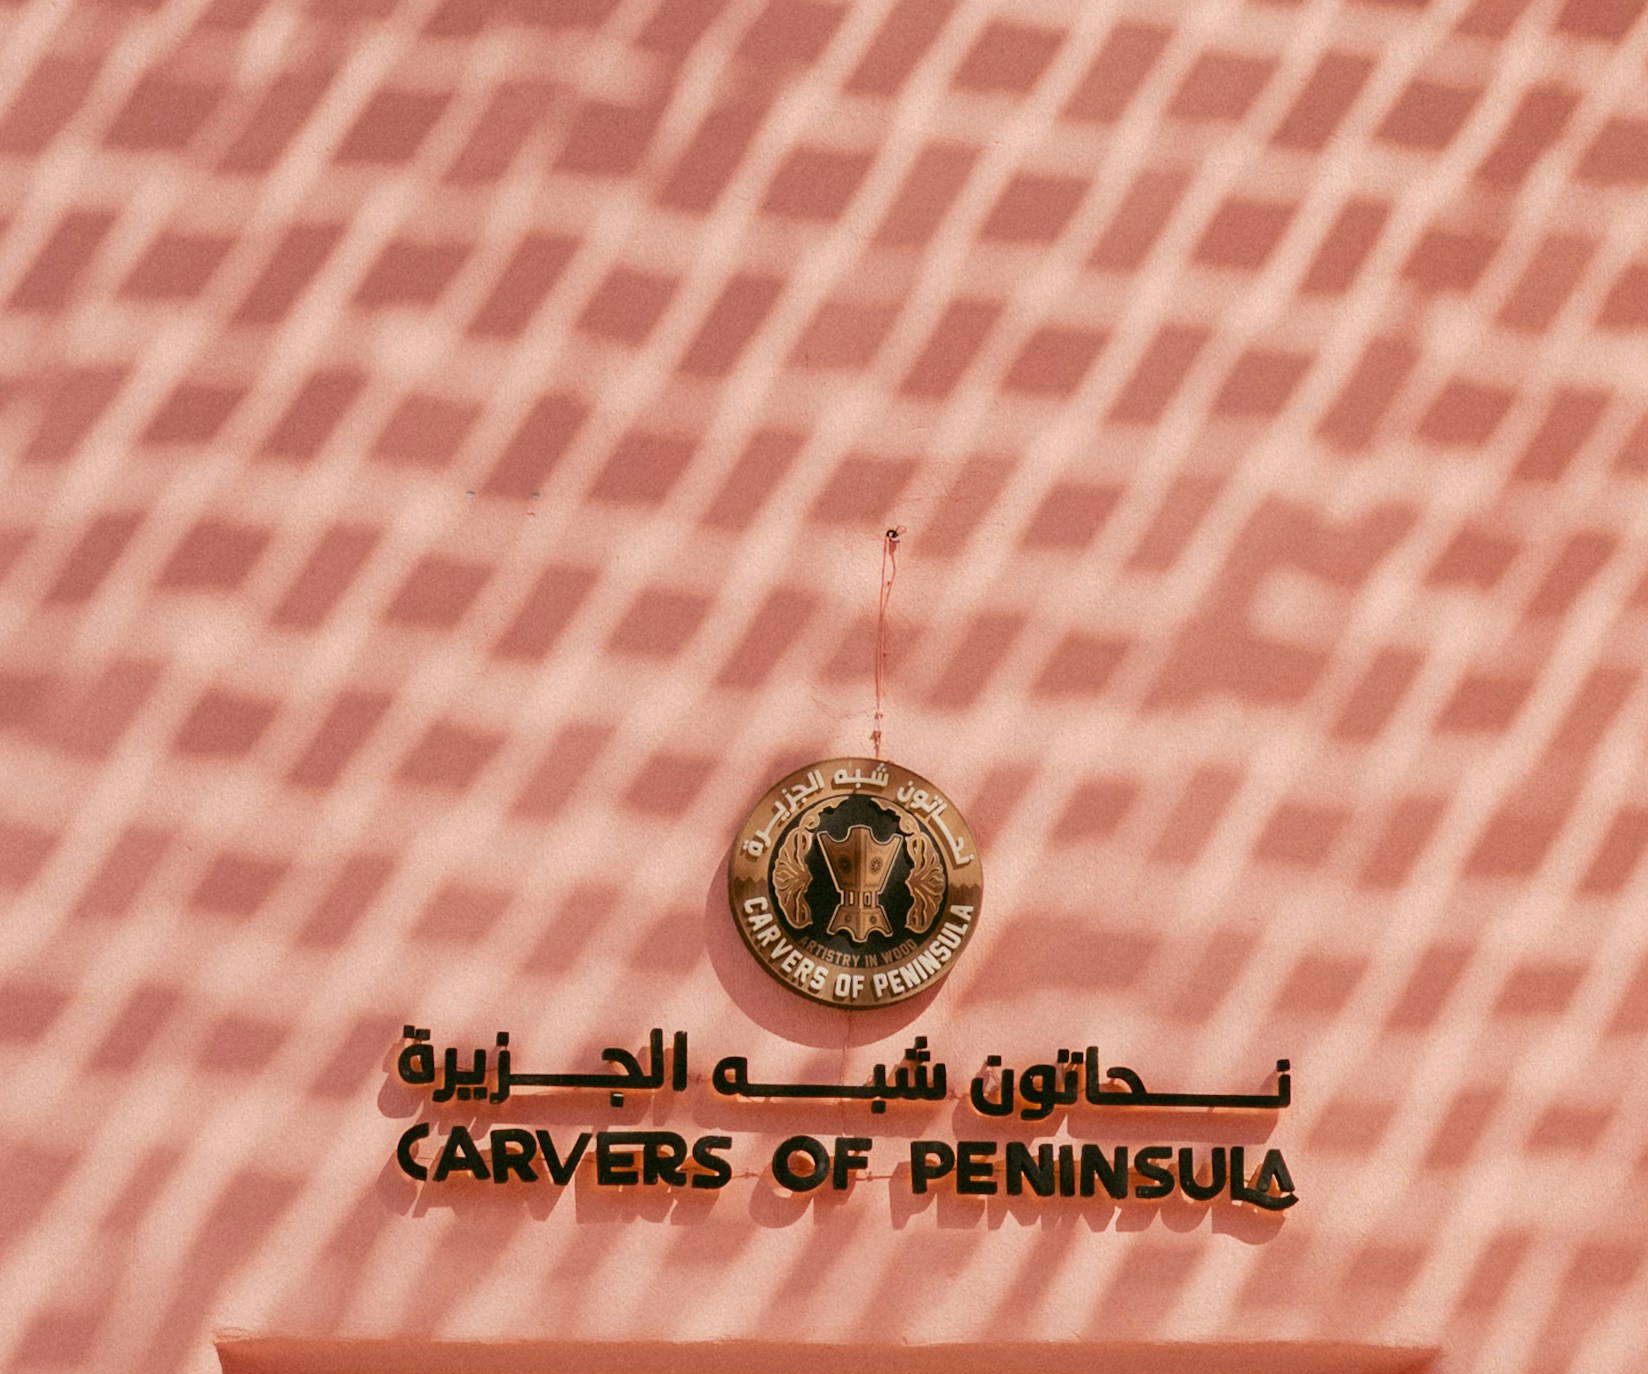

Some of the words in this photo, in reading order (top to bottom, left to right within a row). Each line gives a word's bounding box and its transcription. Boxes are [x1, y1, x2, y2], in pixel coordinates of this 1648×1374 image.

[743, 769, 826, 857] الجزيرة
[833, 762, 890, 788] شبه
[744, 896, 829, 990] CARVERS
[835, 974, 865, 998] OF
[873, 904, 974, 997] PENINSULA
[800, 937, 860, 967] ARTISTRY
[865, 956, 878, 967] IN
[883, 938, 918, 963] WOOD
[397, 1025, 687, 1107] الجزيرة
[712, 1036, 947, 1114] شبه
[397, 1123, 733, 1189] CARVERS
[772, 1135, 873, 1192] OF
[910, 1141, 1300, 1211] PENINSULA
